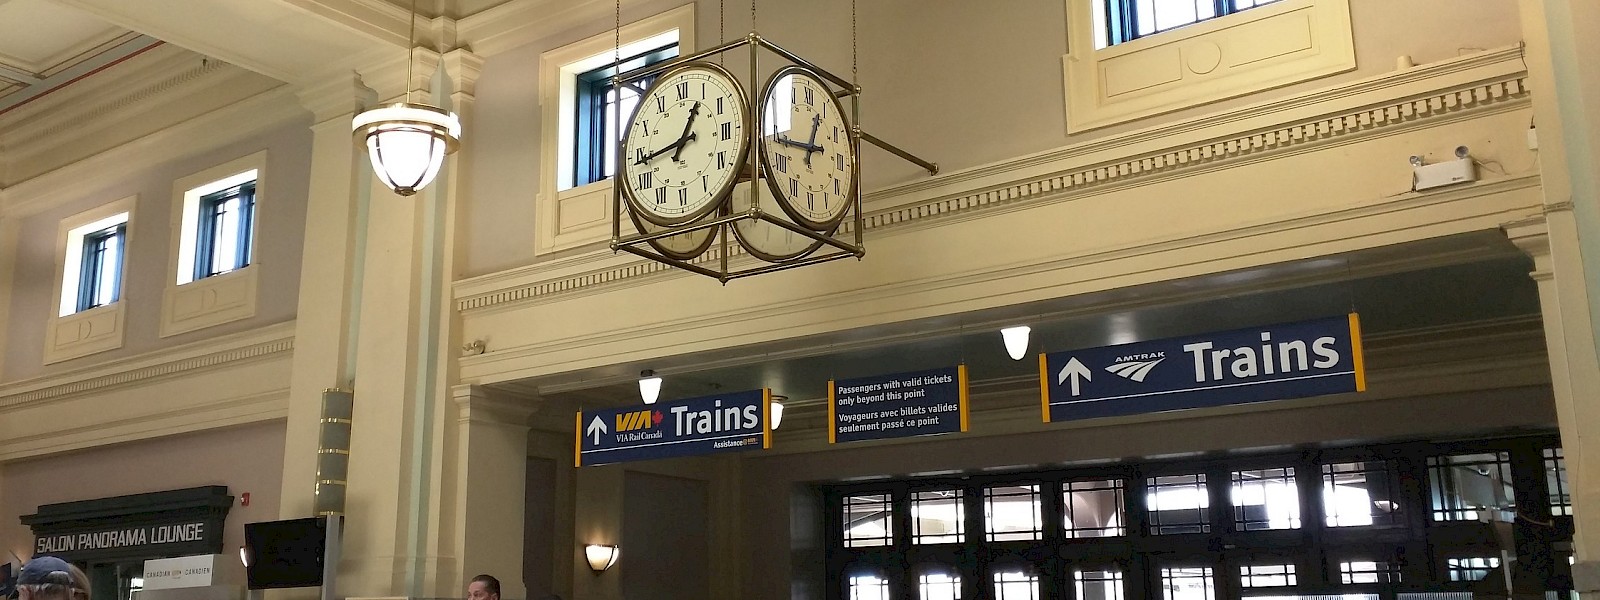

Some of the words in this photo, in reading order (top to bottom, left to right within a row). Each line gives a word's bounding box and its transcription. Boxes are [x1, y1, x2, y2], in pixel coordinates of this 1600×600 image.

[676, 81, 688, 101] XII
[804, 86, 814, 106] XII
[656, 95, 665, 114] XI
[716, 96, 723, 115] II
[642, 120, 649, 137] X
[721, 122, 731, 141] III
[833, 126, 838, 144] II
[717, 151, 726, 170] IV
[775, 152, 787, 173] VIII
[638, 171, 652, 190] VIII
[702, 175, 709, 193] V
[655, 186, 667, 205] VII
[678, 187, 687, 206] VI
[1115, 351, 1166, 363] AMTRAK
[1183, 331, 1340, 383] Trains
[838, 383, 881, 394] Passengers
[883, 380, 900, 390] with
[902, 377, 922, 388] valid
[924, 374, 952, 385] tickets
[838, 396, 855, 407] only
[857, 393, 885, 404] beyond
[886, 390, 902, 401] this
[904, 388, 925, 400] point
[616, 410, 652, 432] VIA
[671, 400, 758, 436] Trains
[838, 412, 879, 423] Voyageurs
[880, 409, 899, 418] avec
[900, 406, 926, 417] billets
[928, 403, 958, 414] valides
[838, 422, 880, 434] seulement
[881, 419, 904, 431] passé
[906, 419, 916, 427] ce
[917, 416, 940, 427] point
[616, 433, 629, 443] VIA
[629, 432, 641, 442] Rail
[713, 439, 744, 449] Assistance
[37, 534, 76, 554] SALON
[78, 528, 147, 550] PANORAMA
[150, 522, 204, 544] LOUNGE
